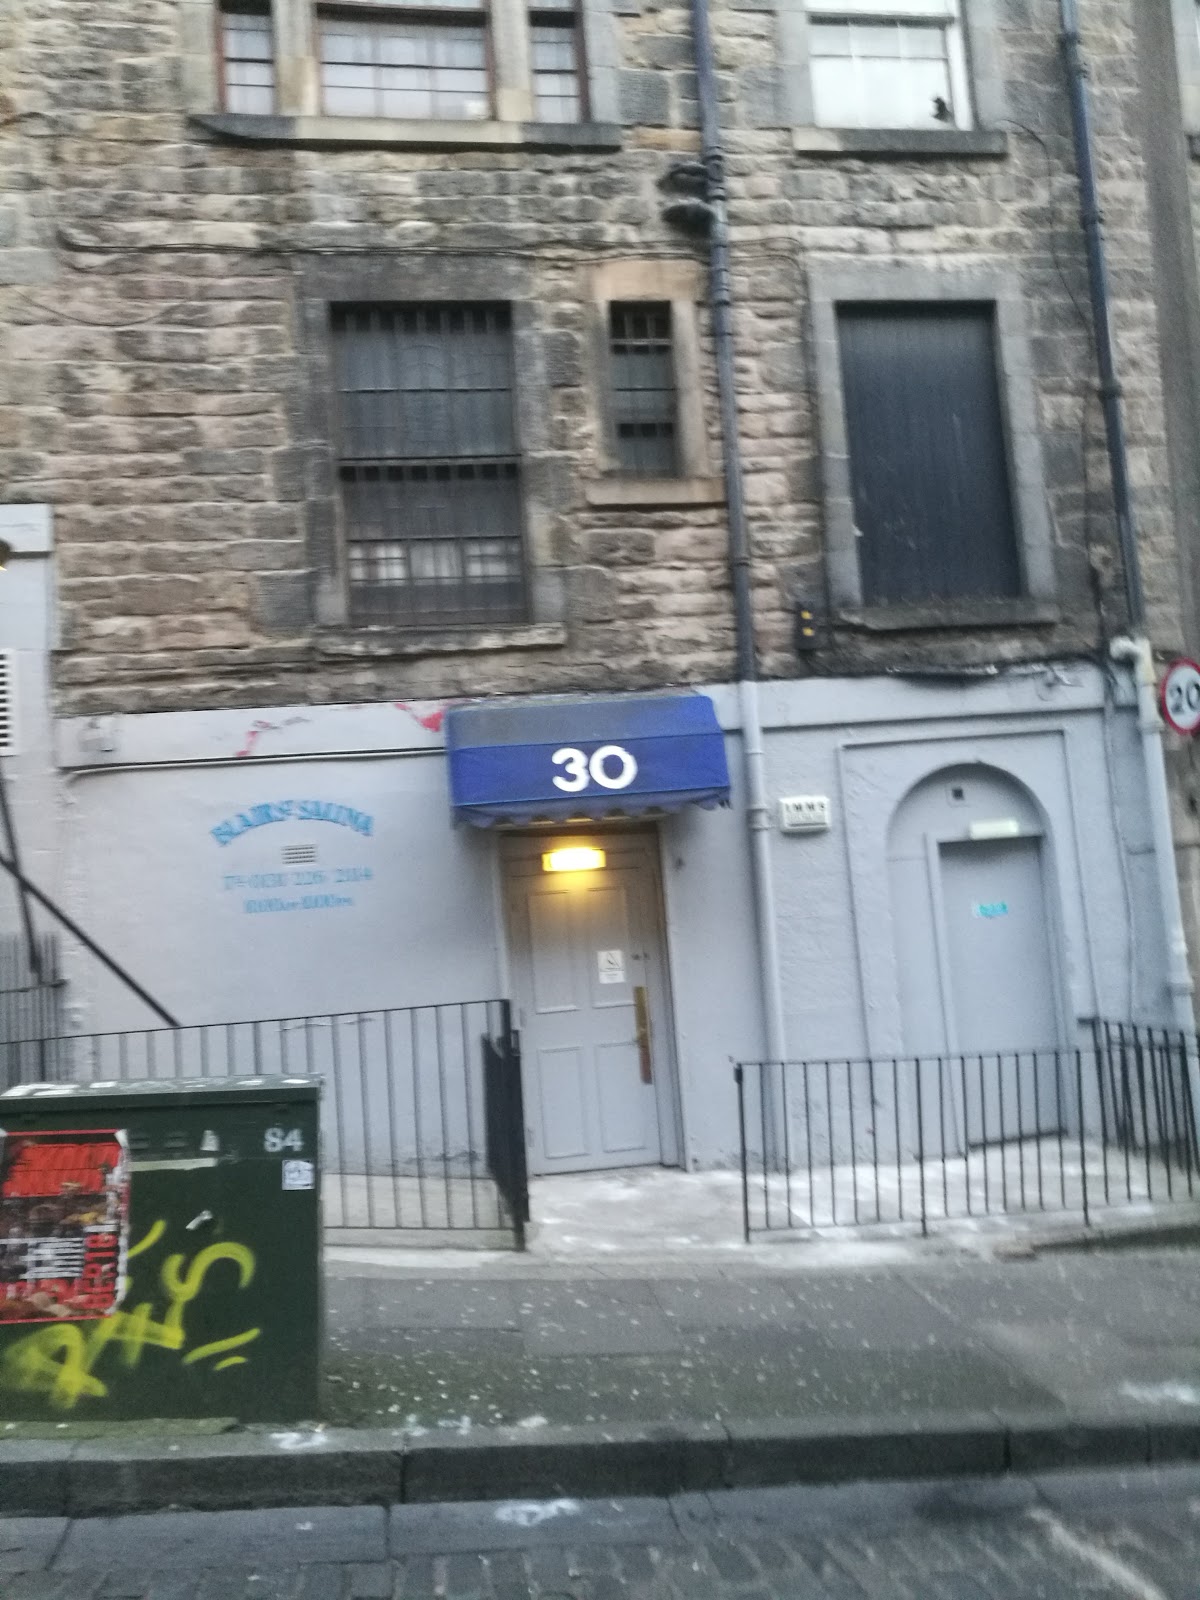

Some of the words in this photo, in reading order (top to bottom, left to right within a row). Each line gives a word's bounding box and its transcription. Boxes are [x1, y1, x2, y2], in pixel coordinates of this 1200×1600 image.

[1168, 681, 1200, 715] 20
[551, 745, 638, 792] 30
[264, 1127, 305, 1152] 84
